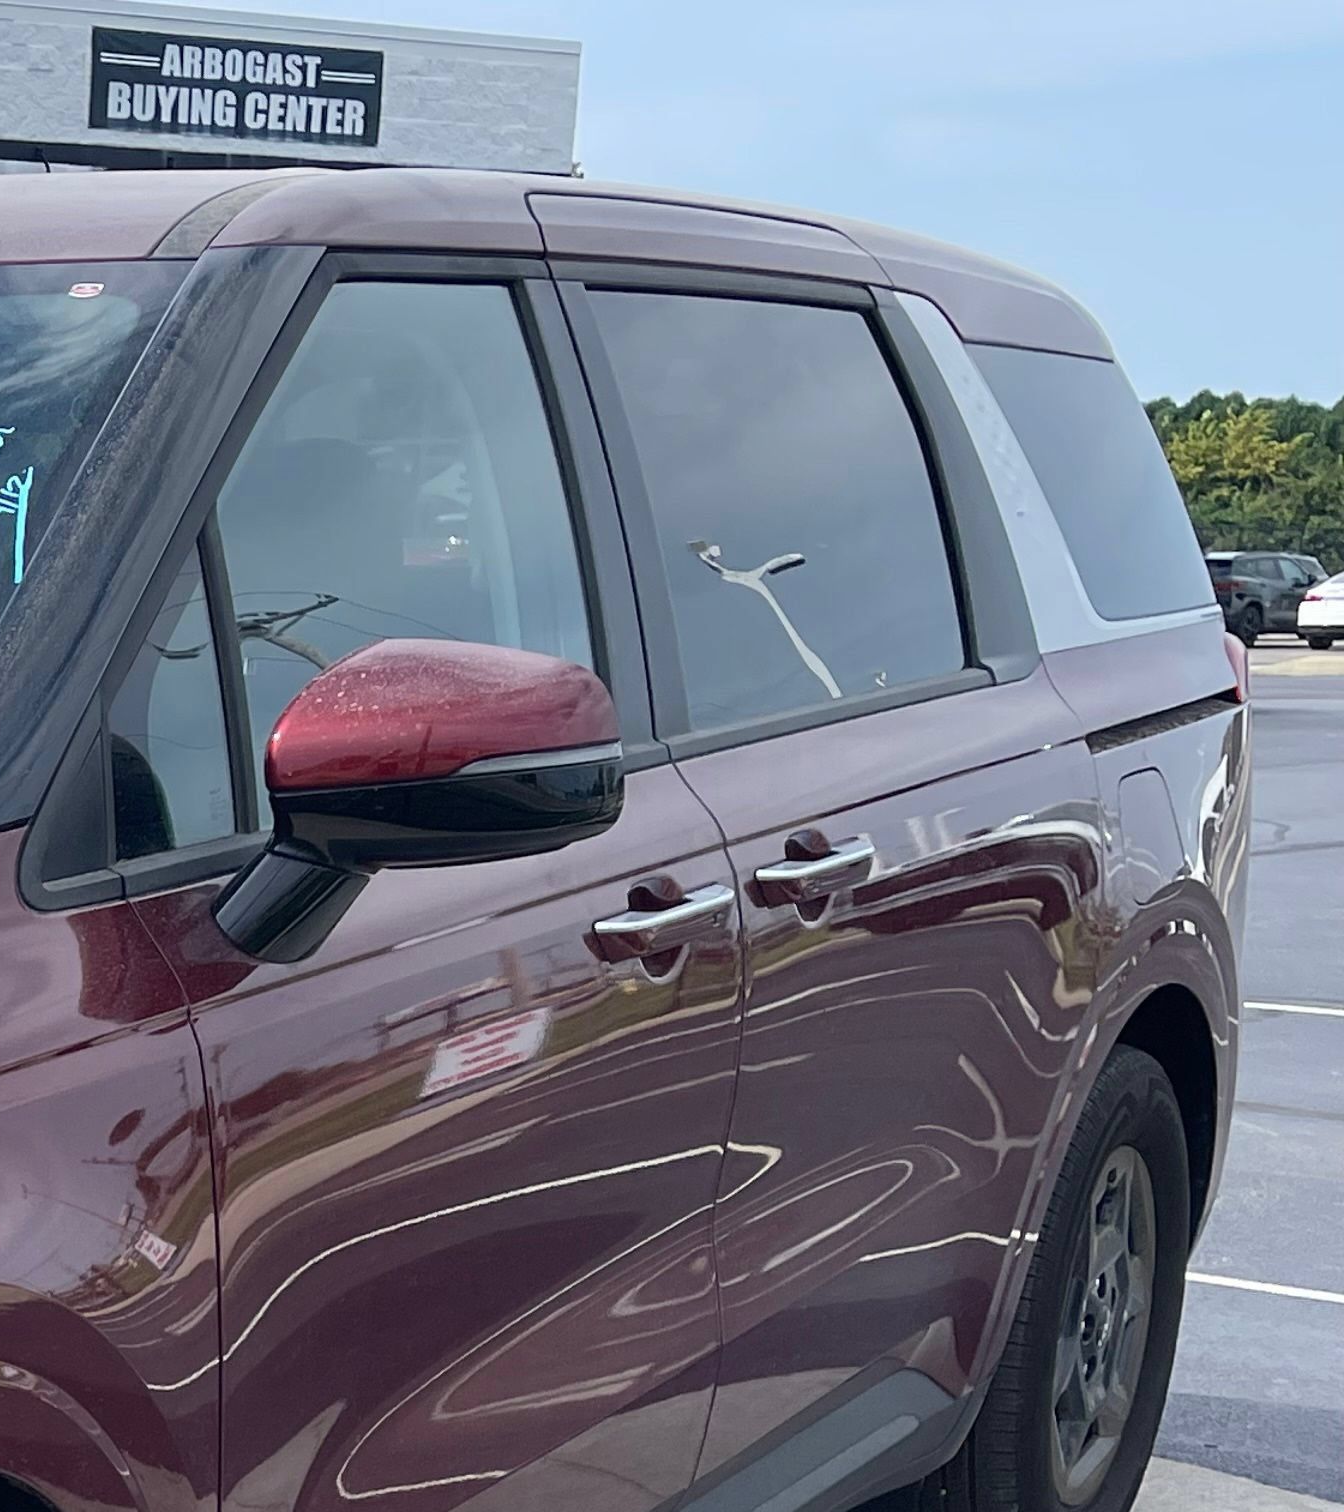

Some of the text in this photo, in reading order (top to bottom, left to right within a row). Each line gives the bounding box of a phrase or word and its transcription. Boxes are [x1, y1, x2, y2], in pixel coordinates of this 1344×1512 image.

[161, 43, 322, 88] ARBOGAST
[107, 81, 366, 136] BUYING CENTER
